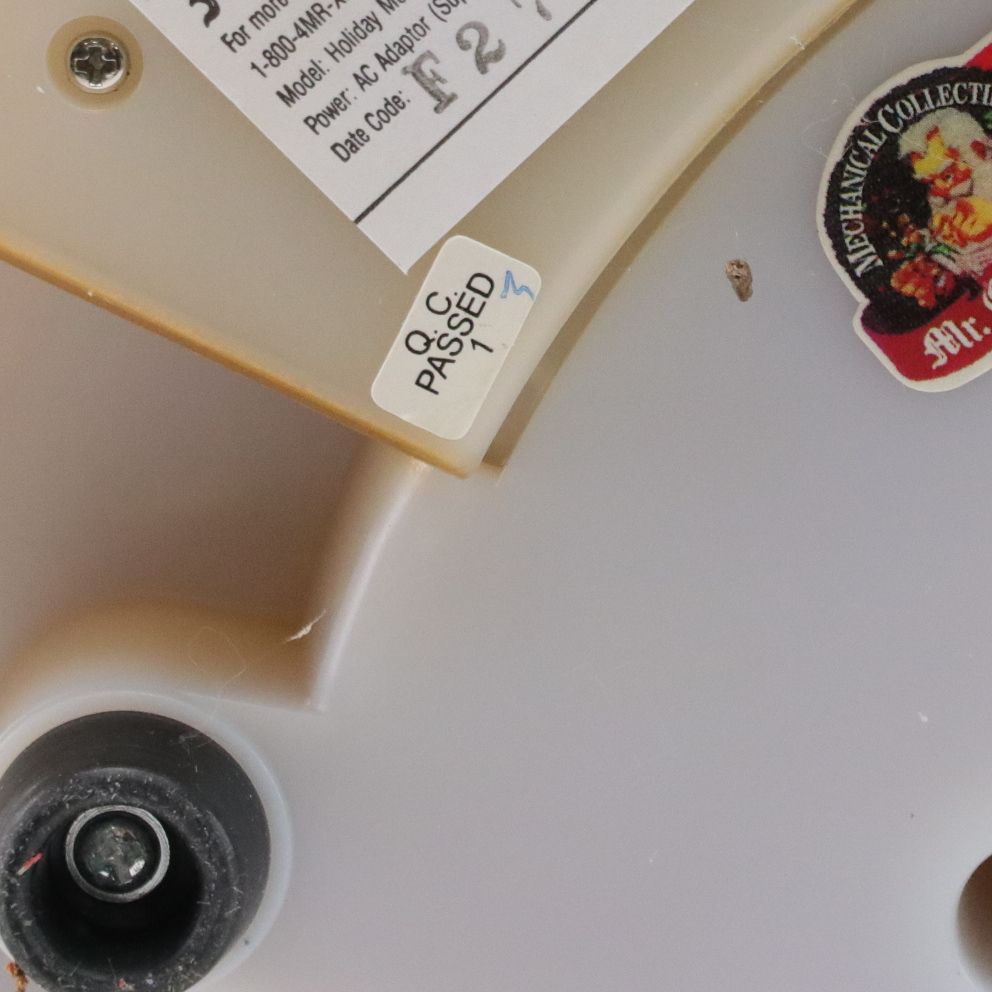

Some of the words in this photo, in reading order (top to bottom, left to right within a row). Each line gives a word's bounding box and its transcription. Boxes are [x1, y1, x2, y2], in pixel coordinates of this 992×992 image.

[220, 25, 251, 53] For
[276, 59, 329, 107] Model:
[324, 11, 383, 63] Holiday
[303, 88, 351, 135] Power:
[353, 64, 378, 91] AC
[374, 17, 430, 72] Adaptor
[330, 129, 370, 162] Date
[364, 91, 410, 131] Code:
[414, 272, 496, 396] PASSED
[470, 338, 495, 354] 1
[924, 318, 990, 369] Mr.
